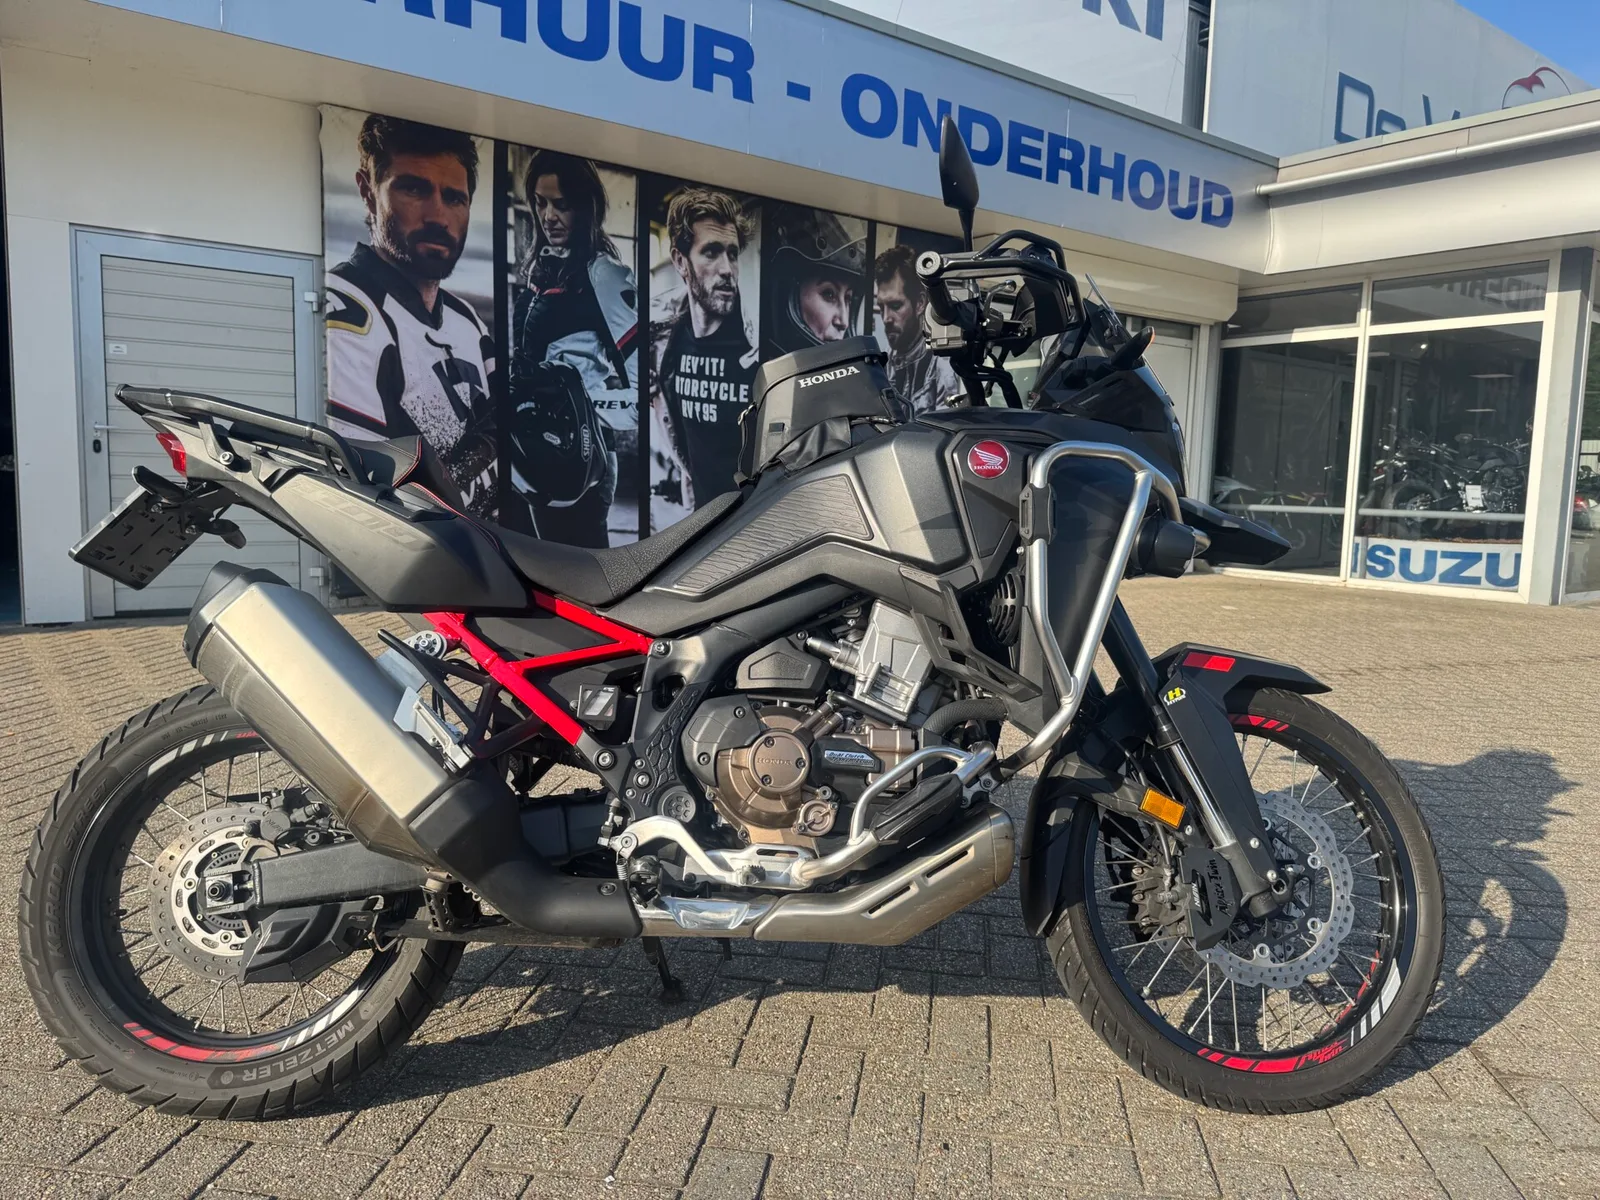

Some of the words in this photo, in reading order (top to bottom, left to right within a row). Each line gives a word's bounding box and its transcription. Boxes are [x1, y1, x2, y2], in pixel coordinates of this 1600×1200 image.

[840, 72, 1235, 229] ONDERHOUD
[797, 365, 861, 389] HONDA
[241, 1019, 356, 1082] METZELER
